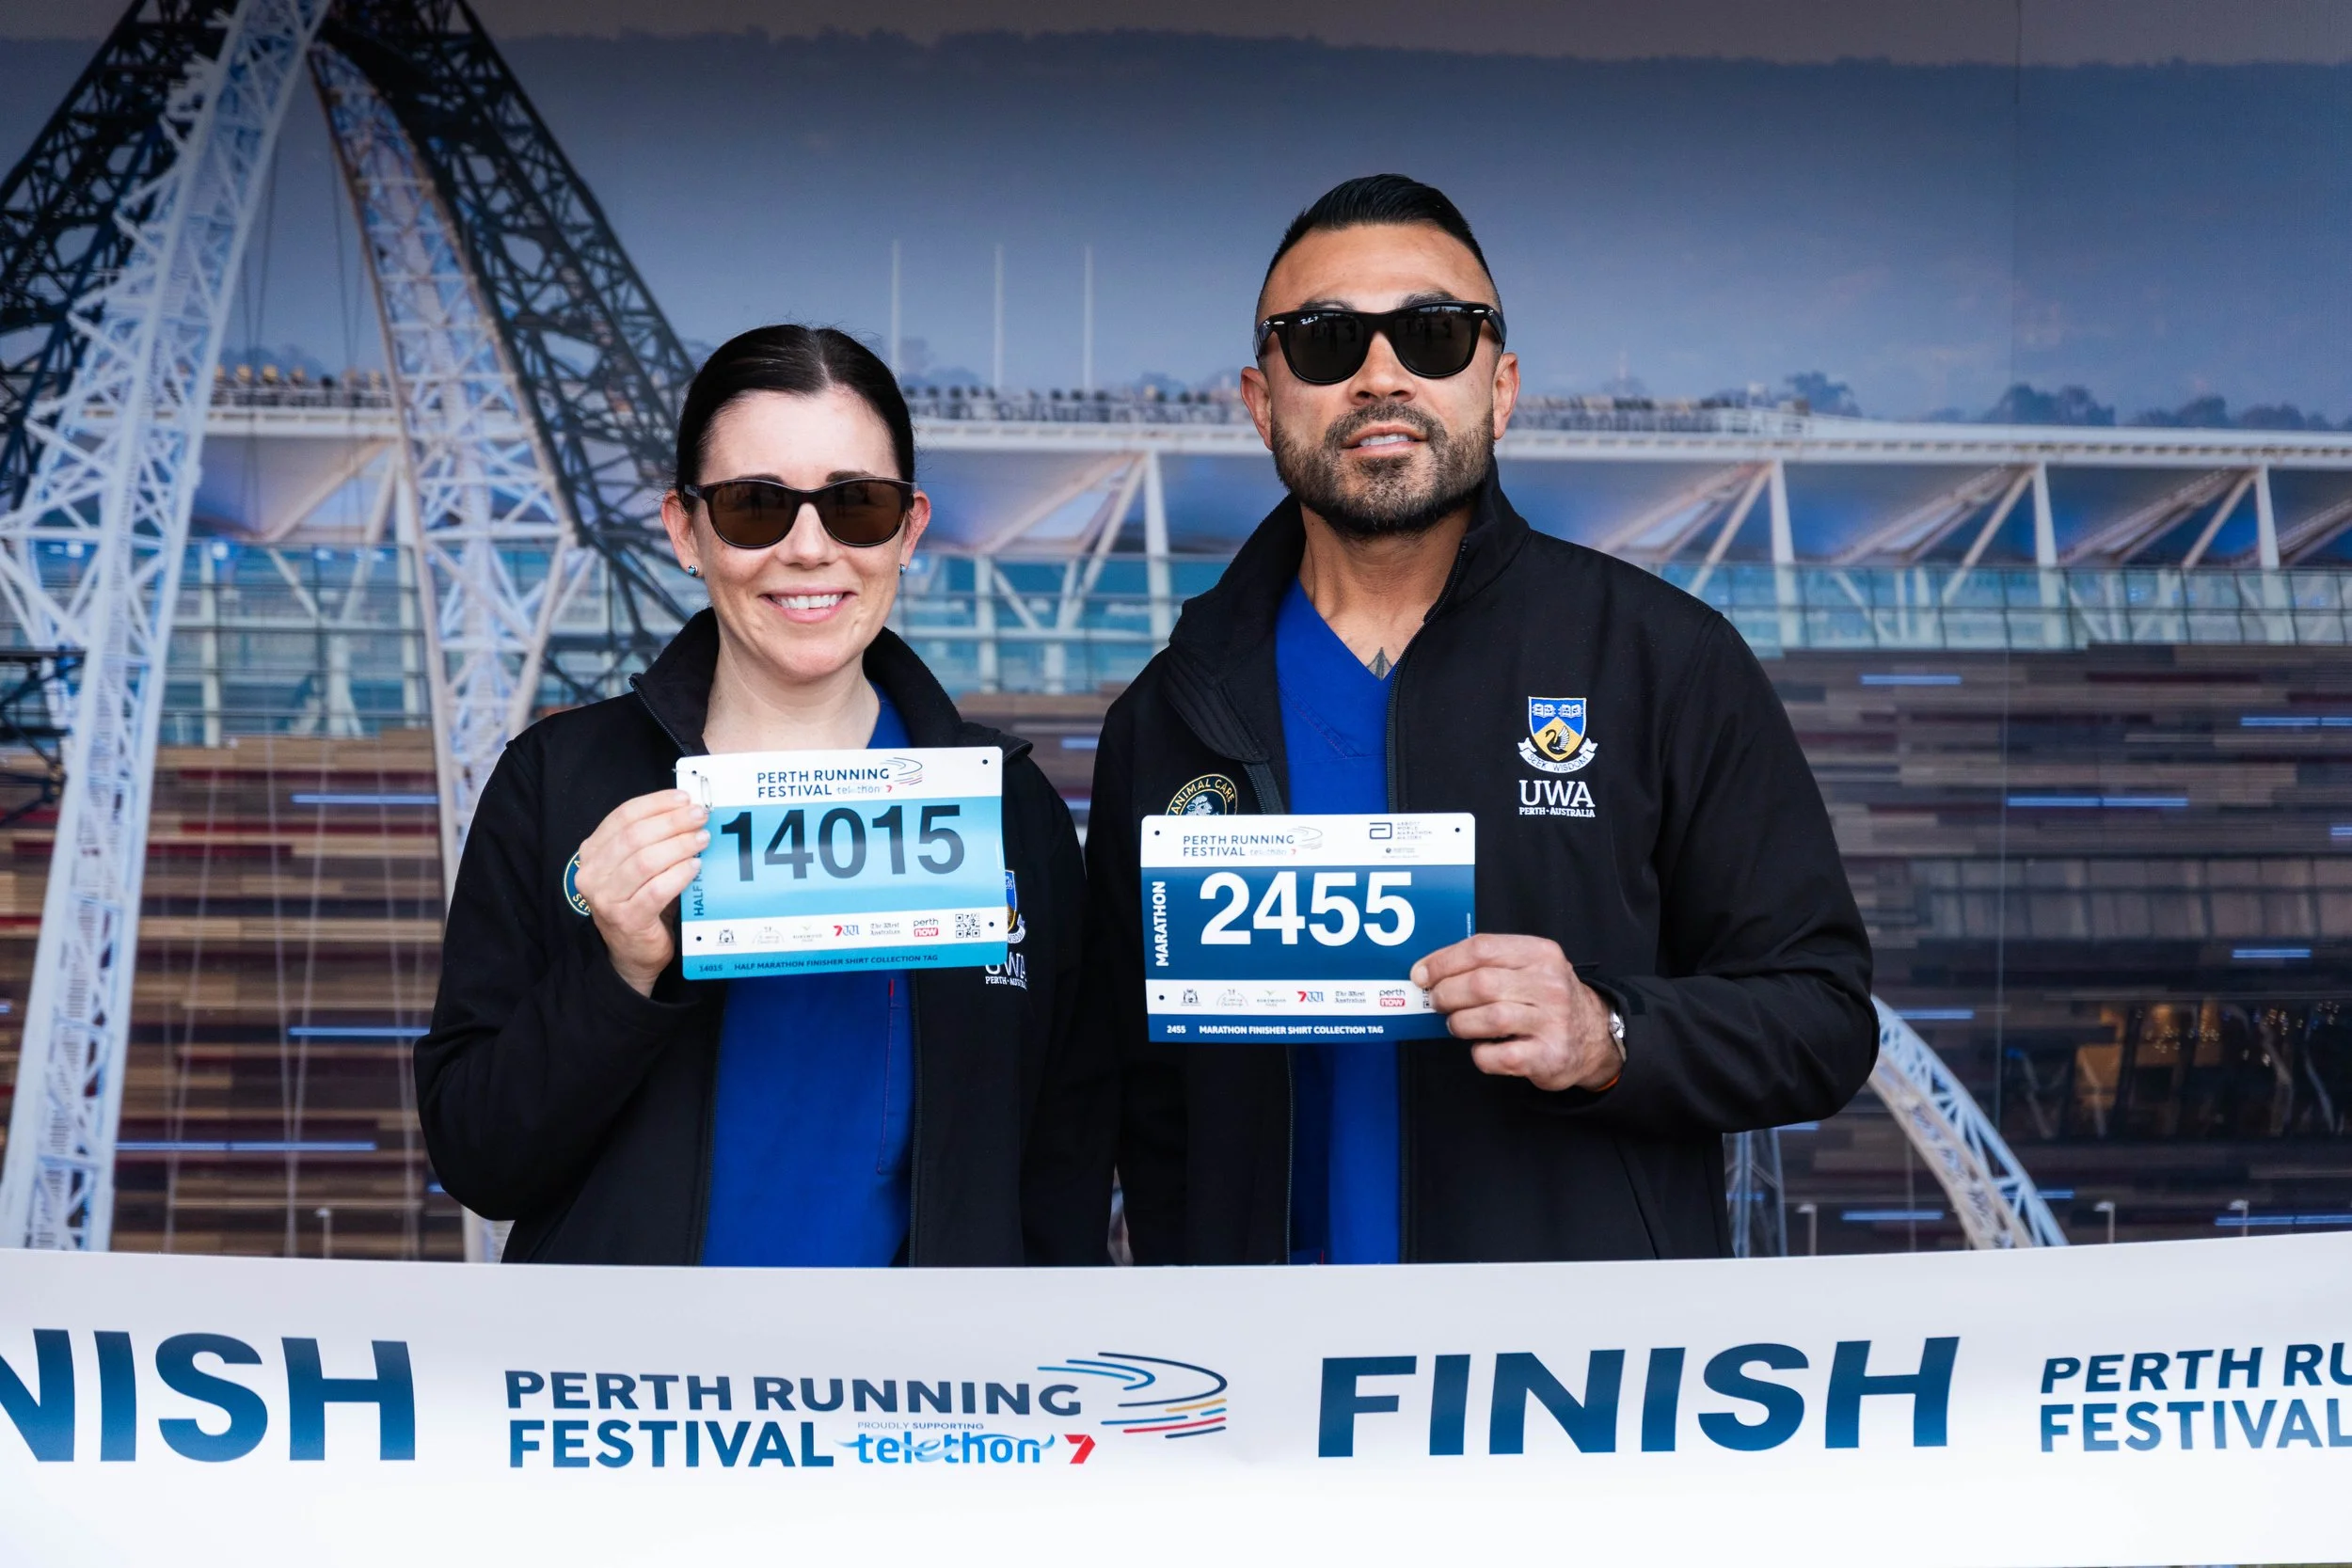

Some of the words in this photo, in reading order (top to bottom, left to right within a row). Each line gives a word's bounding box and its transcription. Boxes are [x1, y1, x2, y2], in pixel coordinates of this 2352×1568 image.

[1527, 753, 1548, 768] SEEK
[1553, 755, 1588, 771] WISDOM
[757, 770, 809, 784] PERTH
[814, 768, 890, 782] RUNNING
[757, 784, 833, 799] FESTIVAL
[1170, 778, 1212, 815] ANIMAL
[1215, 778, 1234, 803] CARE
[1518, 780, 1596, 807] UWA
[721, 804, 965, 882] 14015
[1183, 835, 1227, 845] PERTH
[1231, 834, 1295, 845] RUNNING
[1183, 847, 1246, 857] FESTIVAL
[692, 885, 704, 916] HALF
[1200, 871, 1416, 946] 2455
[914, 918, 939, 927] perth
[915, 928, 938, 937] now
[1152, 880, 1169, 966] MARATHON
[699, 963, 723, 972] 14015
[756, 960, 804, 969] MARATHON
[806, 958, 843, 967] FINISHER
[845, 957, 868, 965] SHIRT
[870, 955, 921, 963] COLLECTION
[1379, 989, 1406, 997] perth
[1381, 998, 1405, 1006] now
[1167, 1024, 1186, 1034] 2455
[1199, 1025, 1248, 1034] MARATHON
[1248, 1025, 1286, 1034] FINISHER
[1288, 1025, 1312, 1034] SHIRT
[1313, 1025, 1366, 1034] COLLECTION
[1367, 1025, 1384, 1034] TAG
[2041, 1347, 2264, 1394] PERTH
[505, 1370, 732, 1411] PERTH
[754, 1376, 1081, 1417] RUNNING
[1318, 1336, 1961, 1458] FINISH
[858, 1421, 910, 1431] PROUDLY
[913, 1422, 984, 1431] SUPPORTING
[2040, 1398, 2352, 1452] FESTIVAL
[509, 1419, 834, 1468] FESTIVAL
[855, 1431, 1042, 1465] telethon
